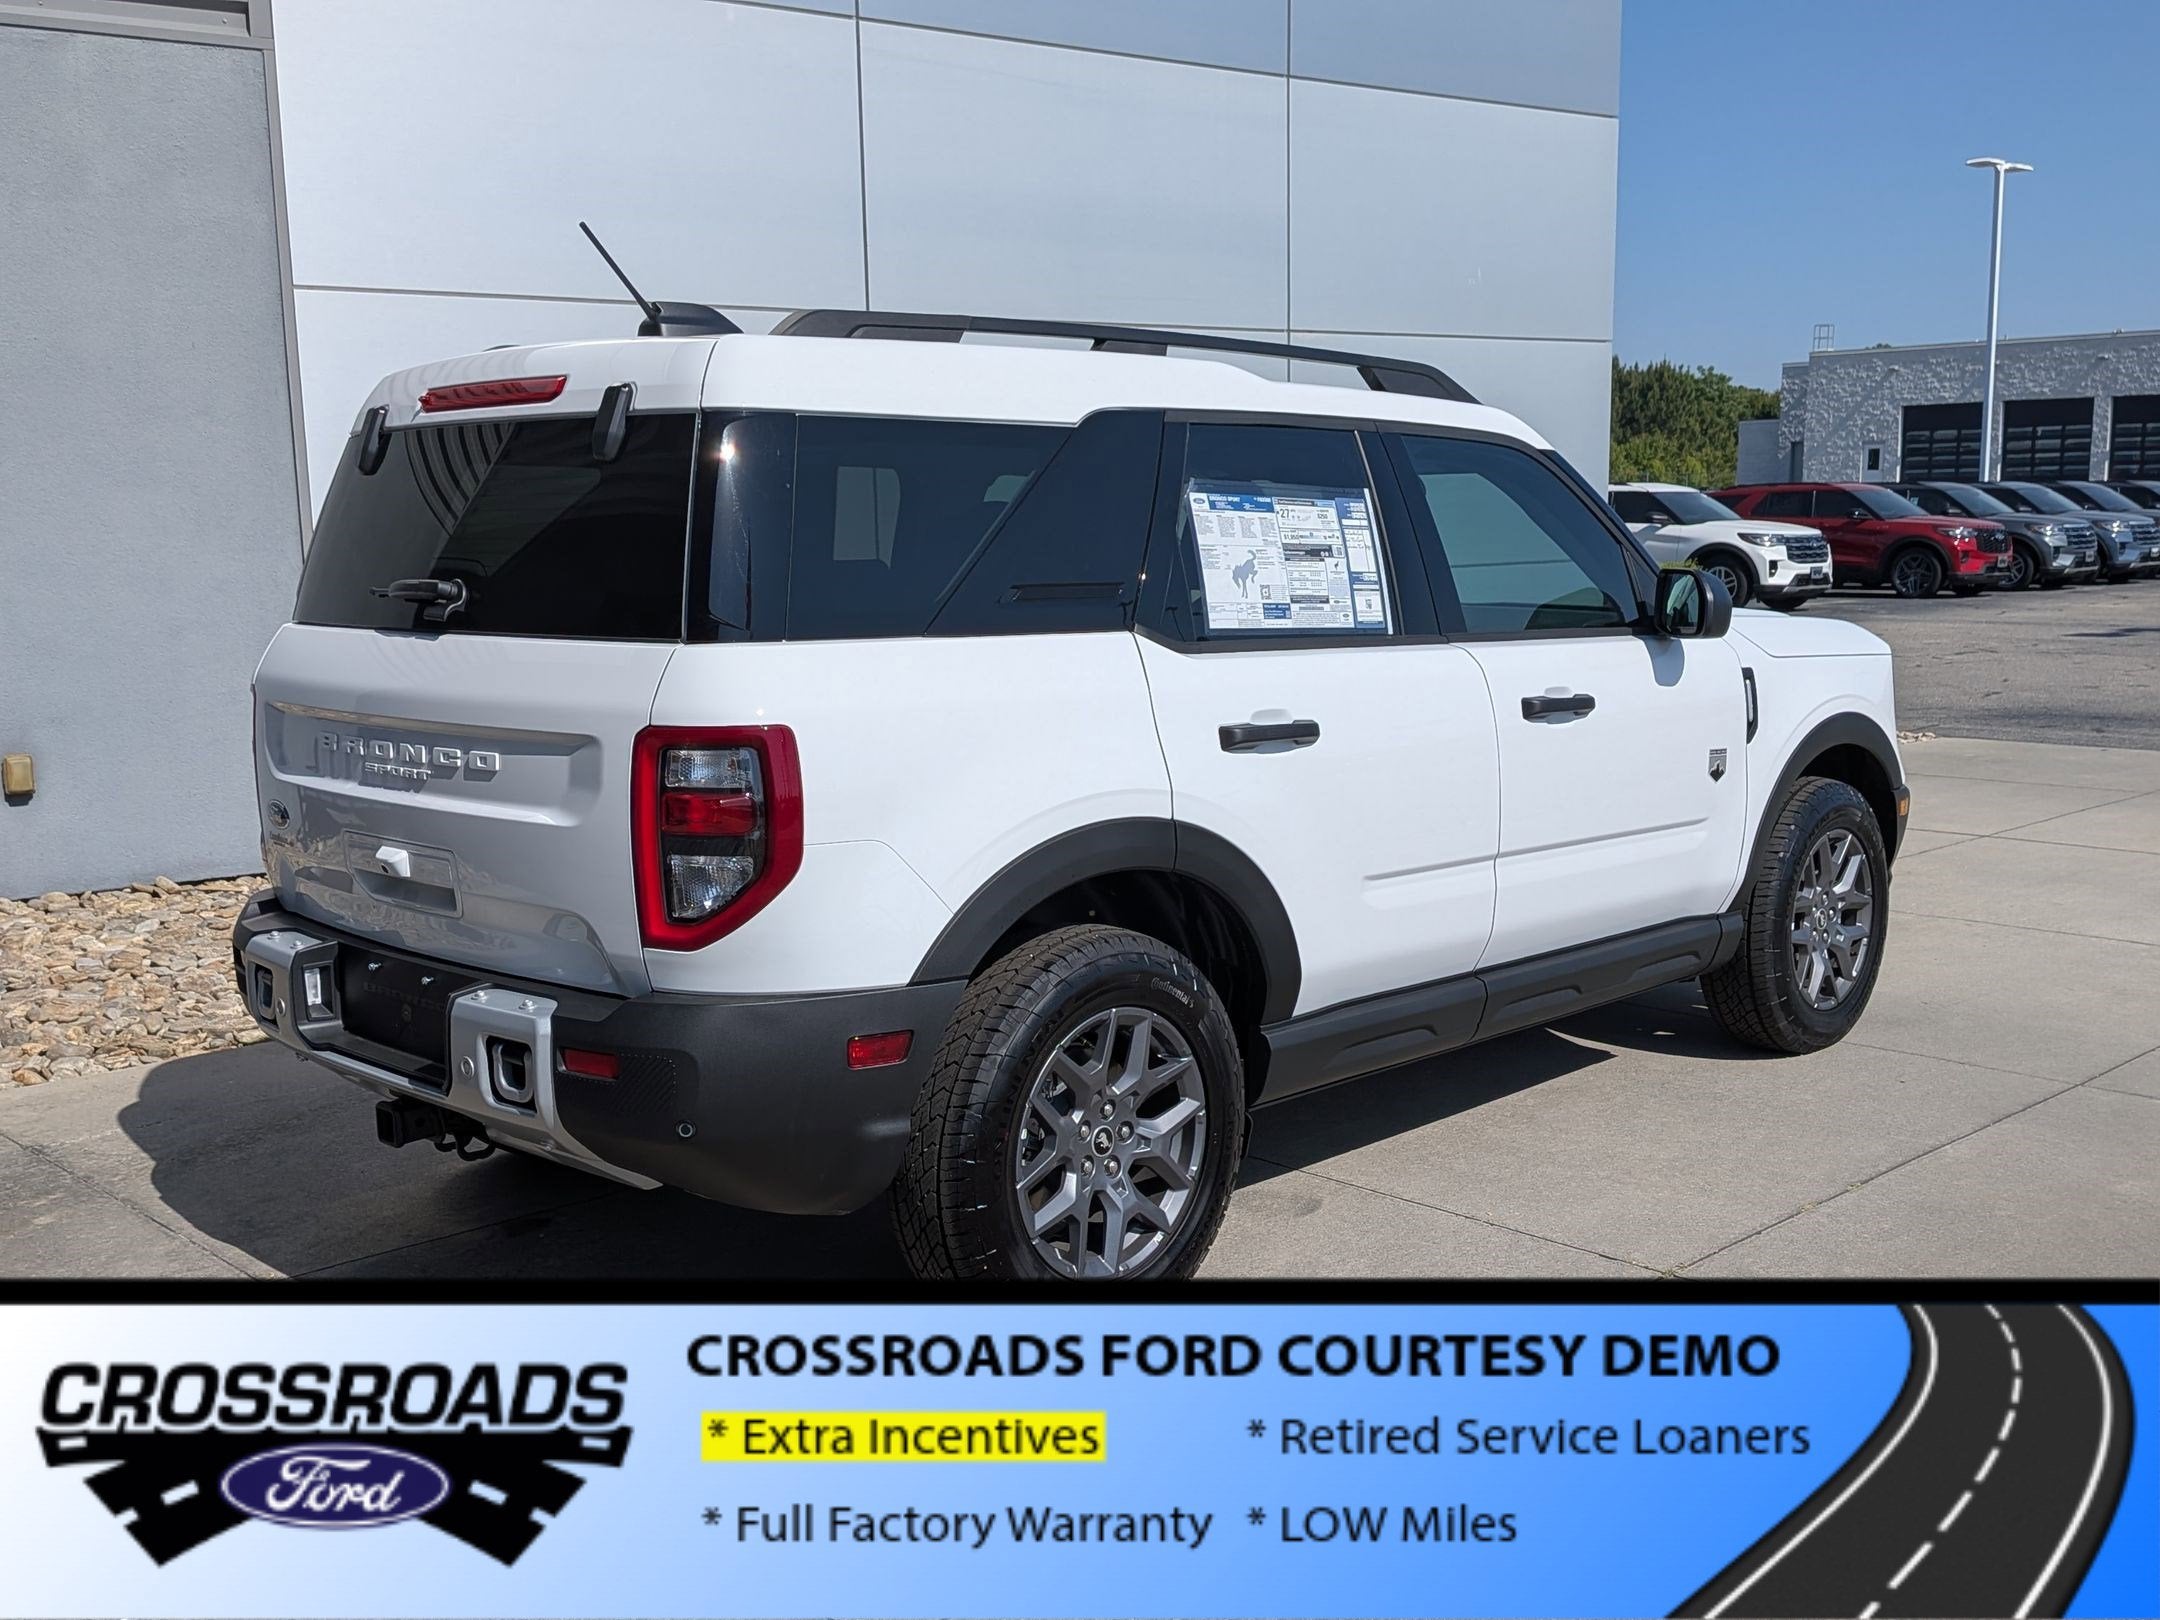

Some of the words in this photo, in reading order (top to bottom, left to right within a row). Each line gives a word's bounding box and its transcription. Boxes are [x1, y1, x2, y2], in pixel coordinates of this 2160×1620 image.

[1280, 508, 1289, 518] 27
[319, 731, 500, 772] BRONCO
[364, 762, 432, 781] SPORT
